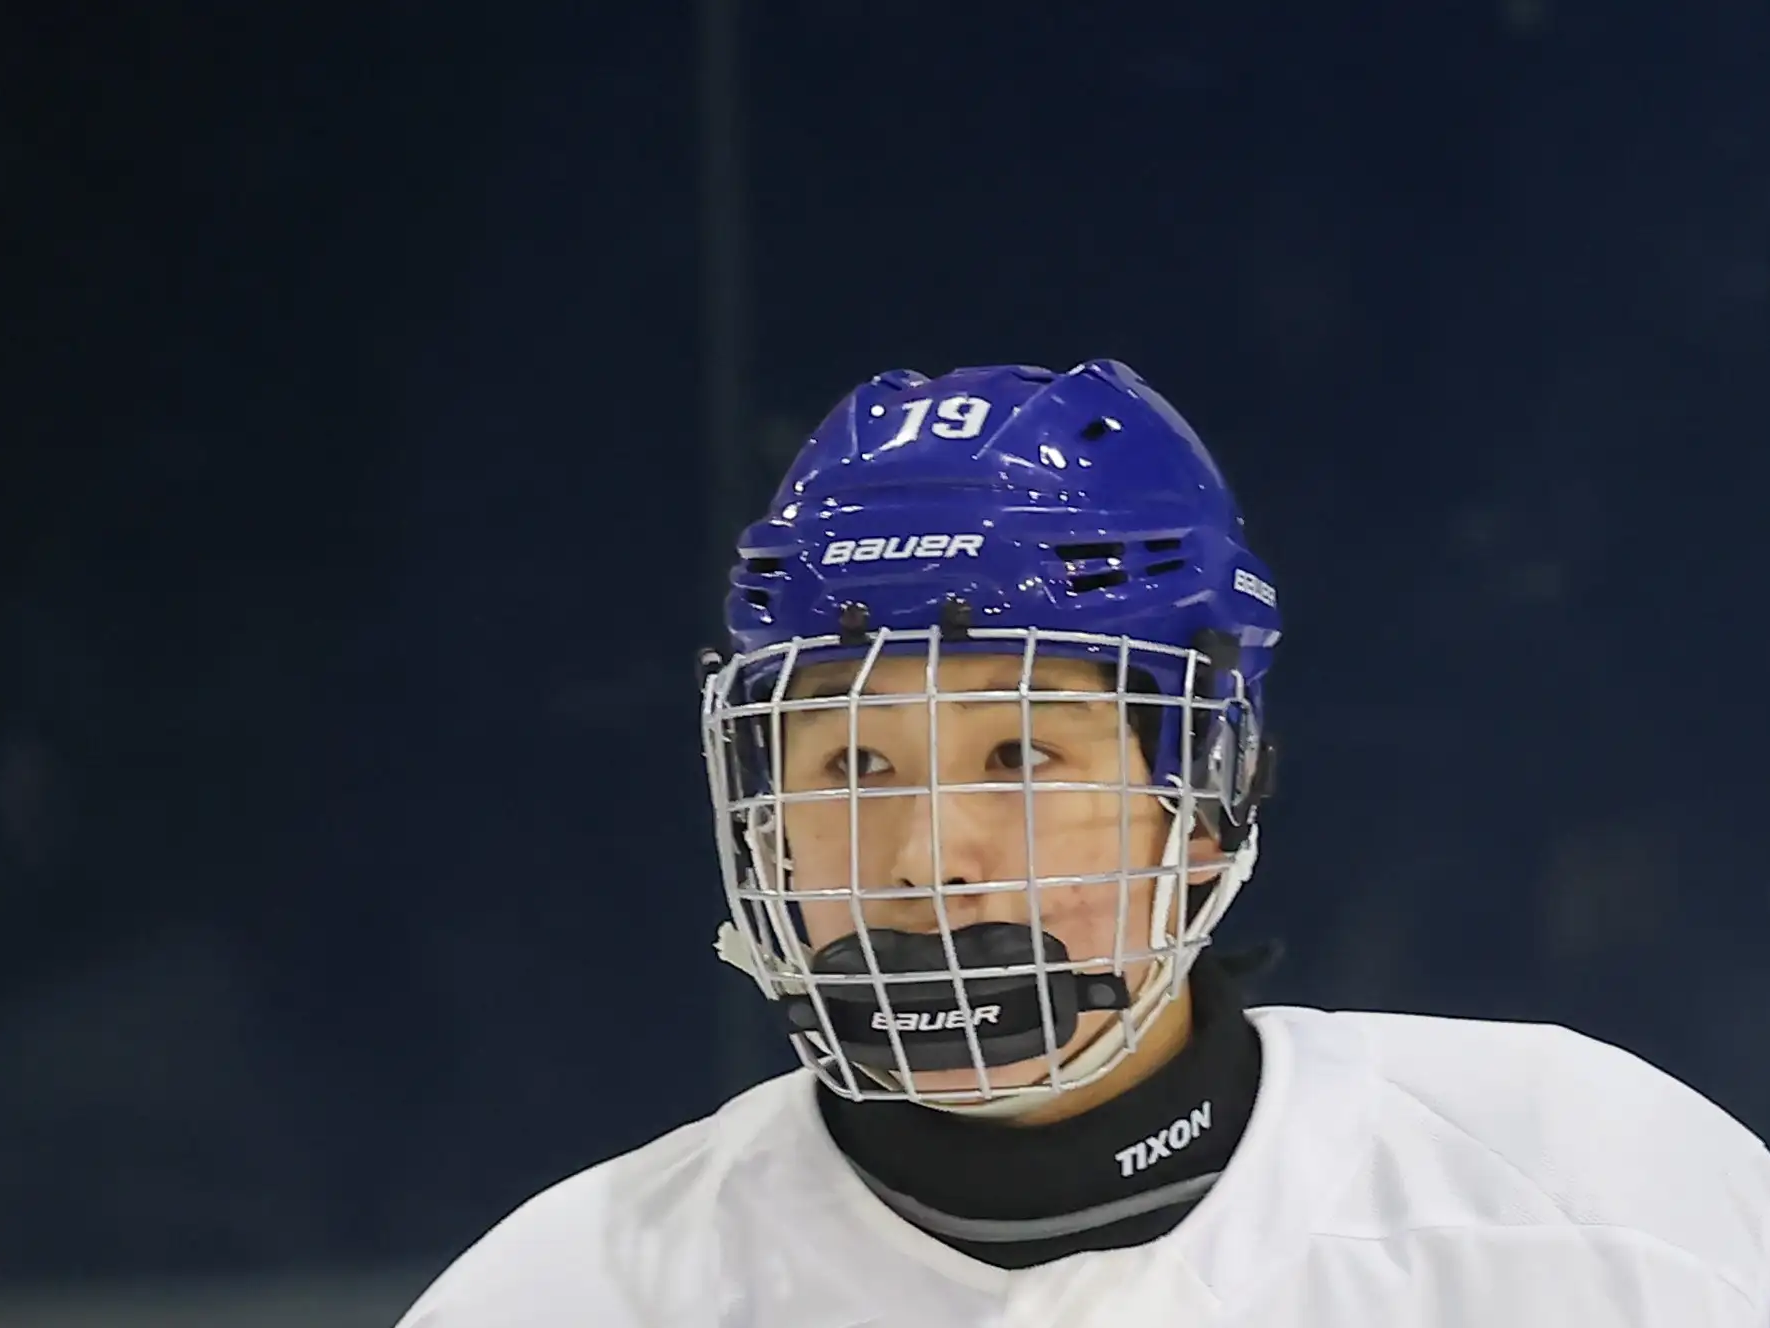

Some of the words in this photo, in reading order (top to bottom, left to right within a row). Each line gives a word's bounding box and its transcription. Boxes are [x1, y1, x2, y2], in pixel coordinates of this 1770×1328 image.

[879, 396, 991, 451] 19
[821, 533, 984, 566] BAUER
[1115, 1100, 1213, 1178] TIXON
